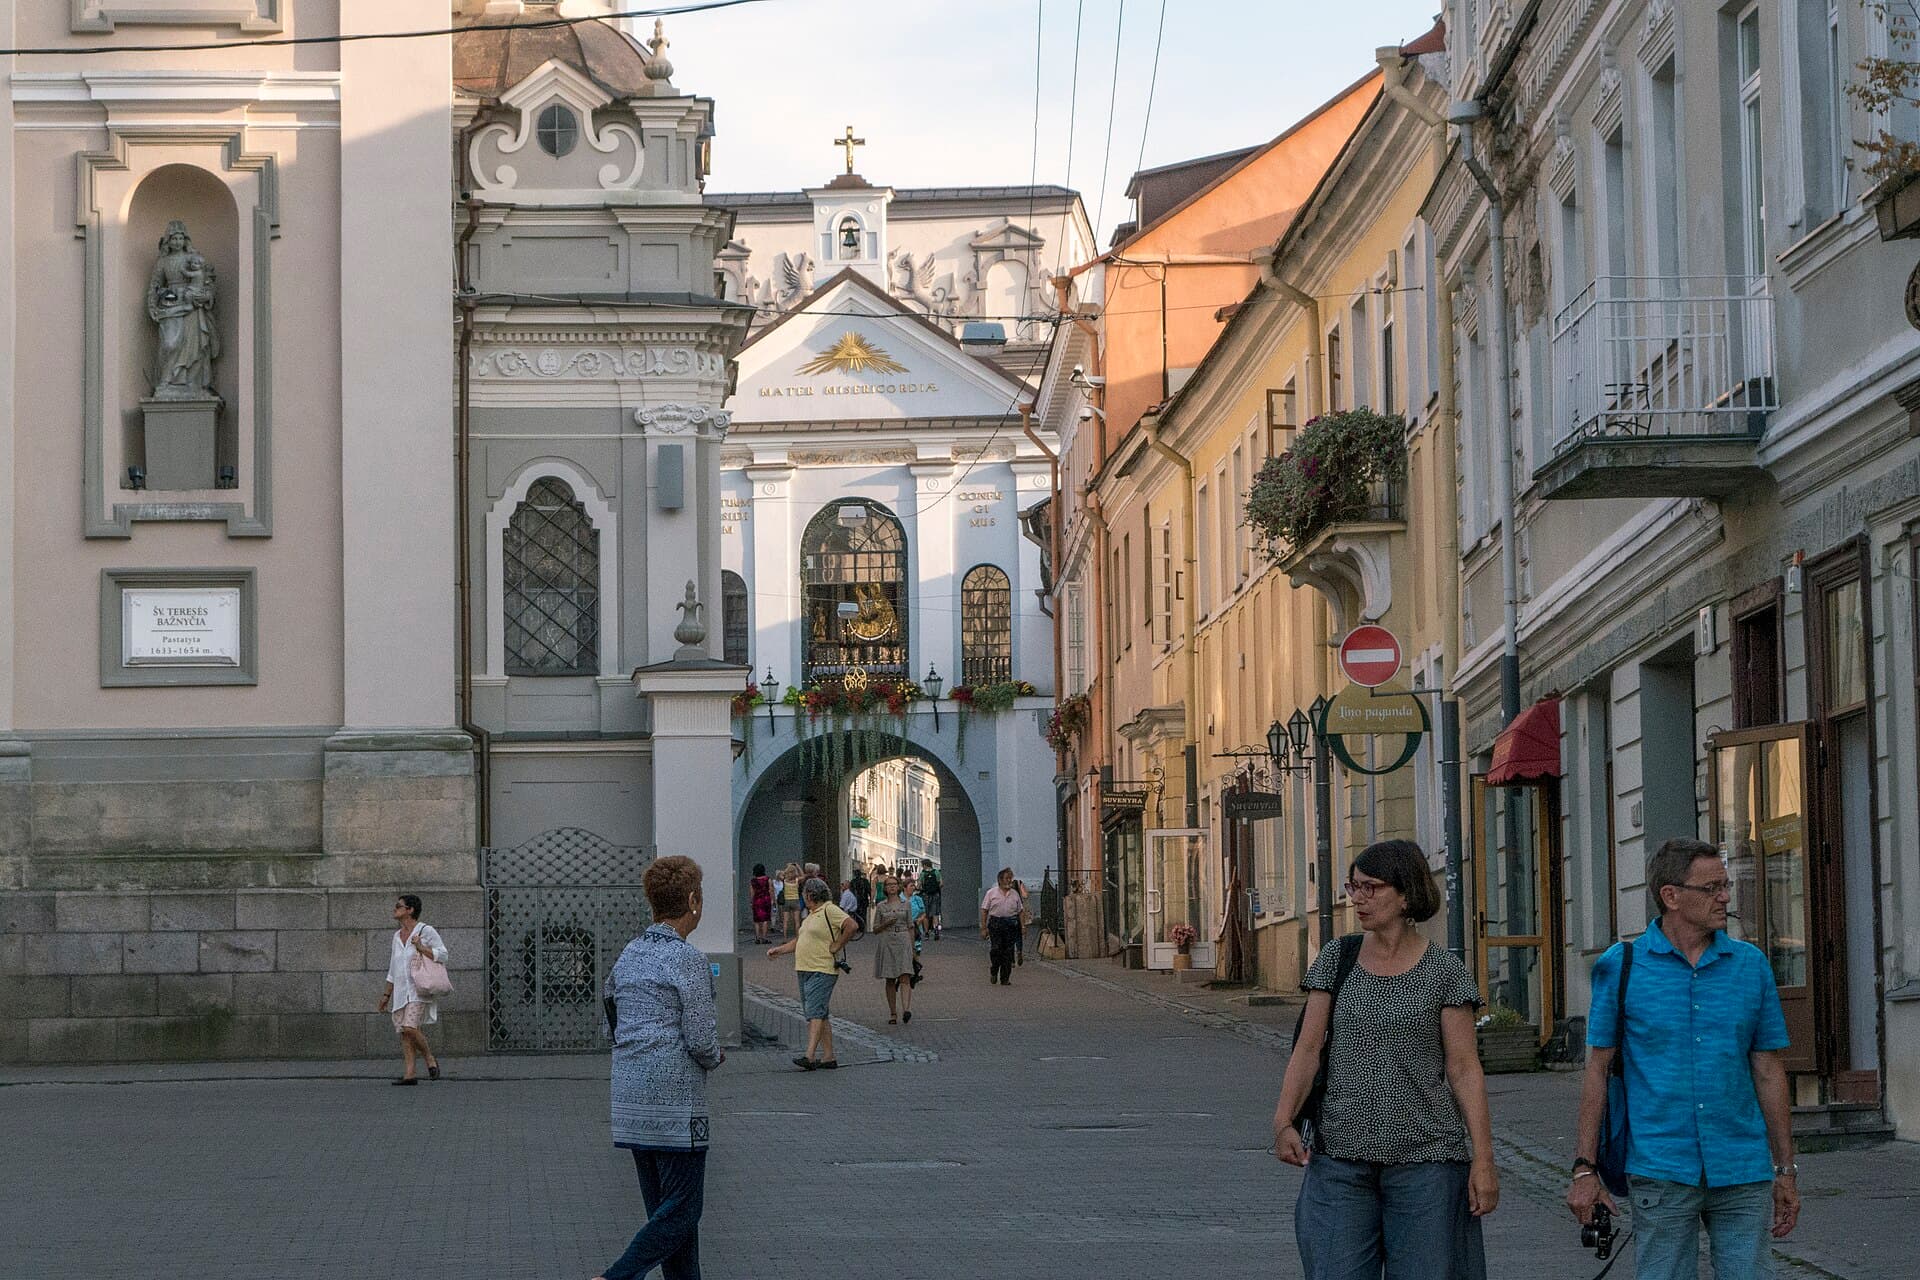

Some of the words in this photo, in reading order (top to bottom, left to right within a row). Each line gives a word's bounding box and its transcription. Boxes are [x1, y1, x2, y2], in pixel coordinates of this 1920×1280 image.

[760, 386, 814, 397] MATER
[969, 518, 996, 528] MUS
[167, 606, 208, 616] TERESĖS
[157, 615, 206, 626] BAŽNYČIA
[162, 636, 201, 645] Pastatyta
[1339, 705, 1361, 719] Lino
